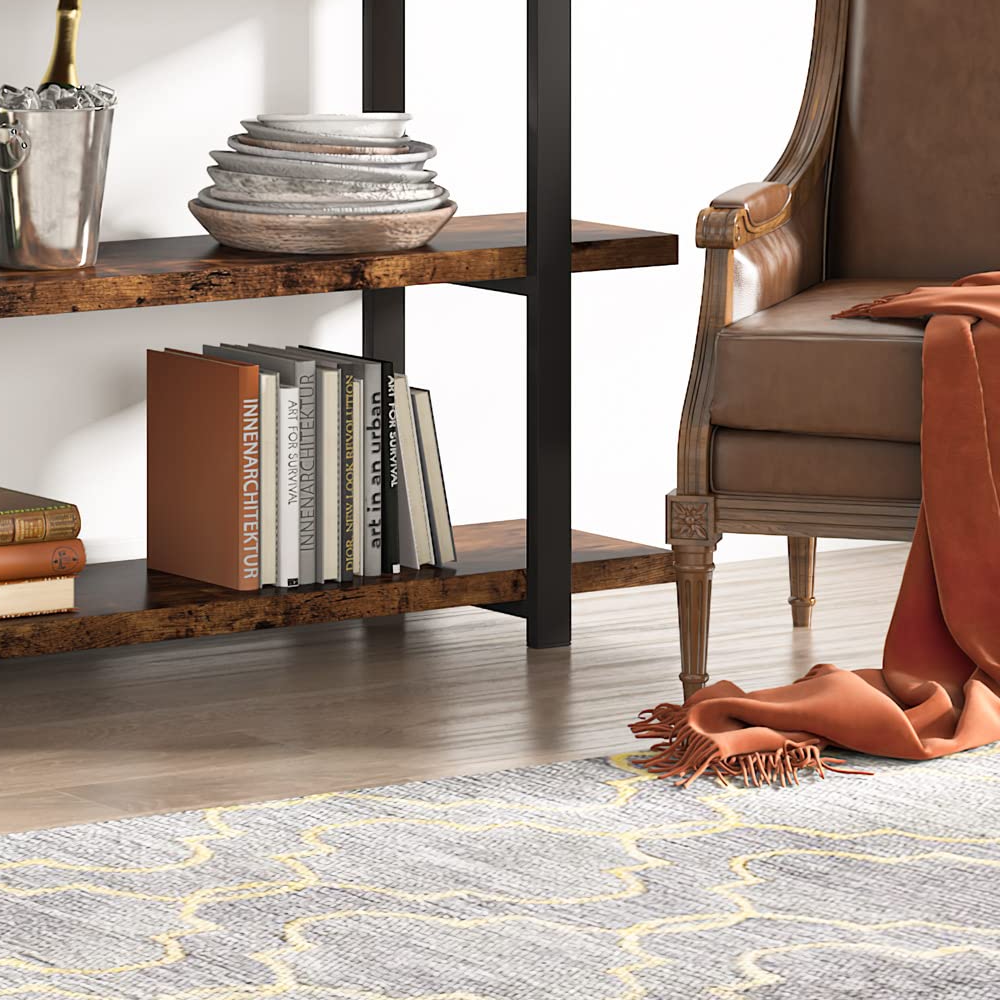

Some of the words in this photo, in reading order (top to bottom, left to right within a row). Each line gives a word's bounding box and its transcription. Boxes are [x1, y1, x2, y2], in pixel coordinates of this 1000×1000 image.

[287, 399, 298, 421] ART
[366, 391, 381, 454] urban
[287, 426, 298, 450] FOR
[287, 453, 298, 505] SURVIVAL
[299, 374, 316, 552] INNENARCHITEKTUR
[370, 460, 381, 485] an
[389, 431, 398, 487] SURVIVAL
[242, 398, 259, 579] INNENARCHITEKTUR
[367, 492, 381, 513] in
[368, 519, 381, 549] art
